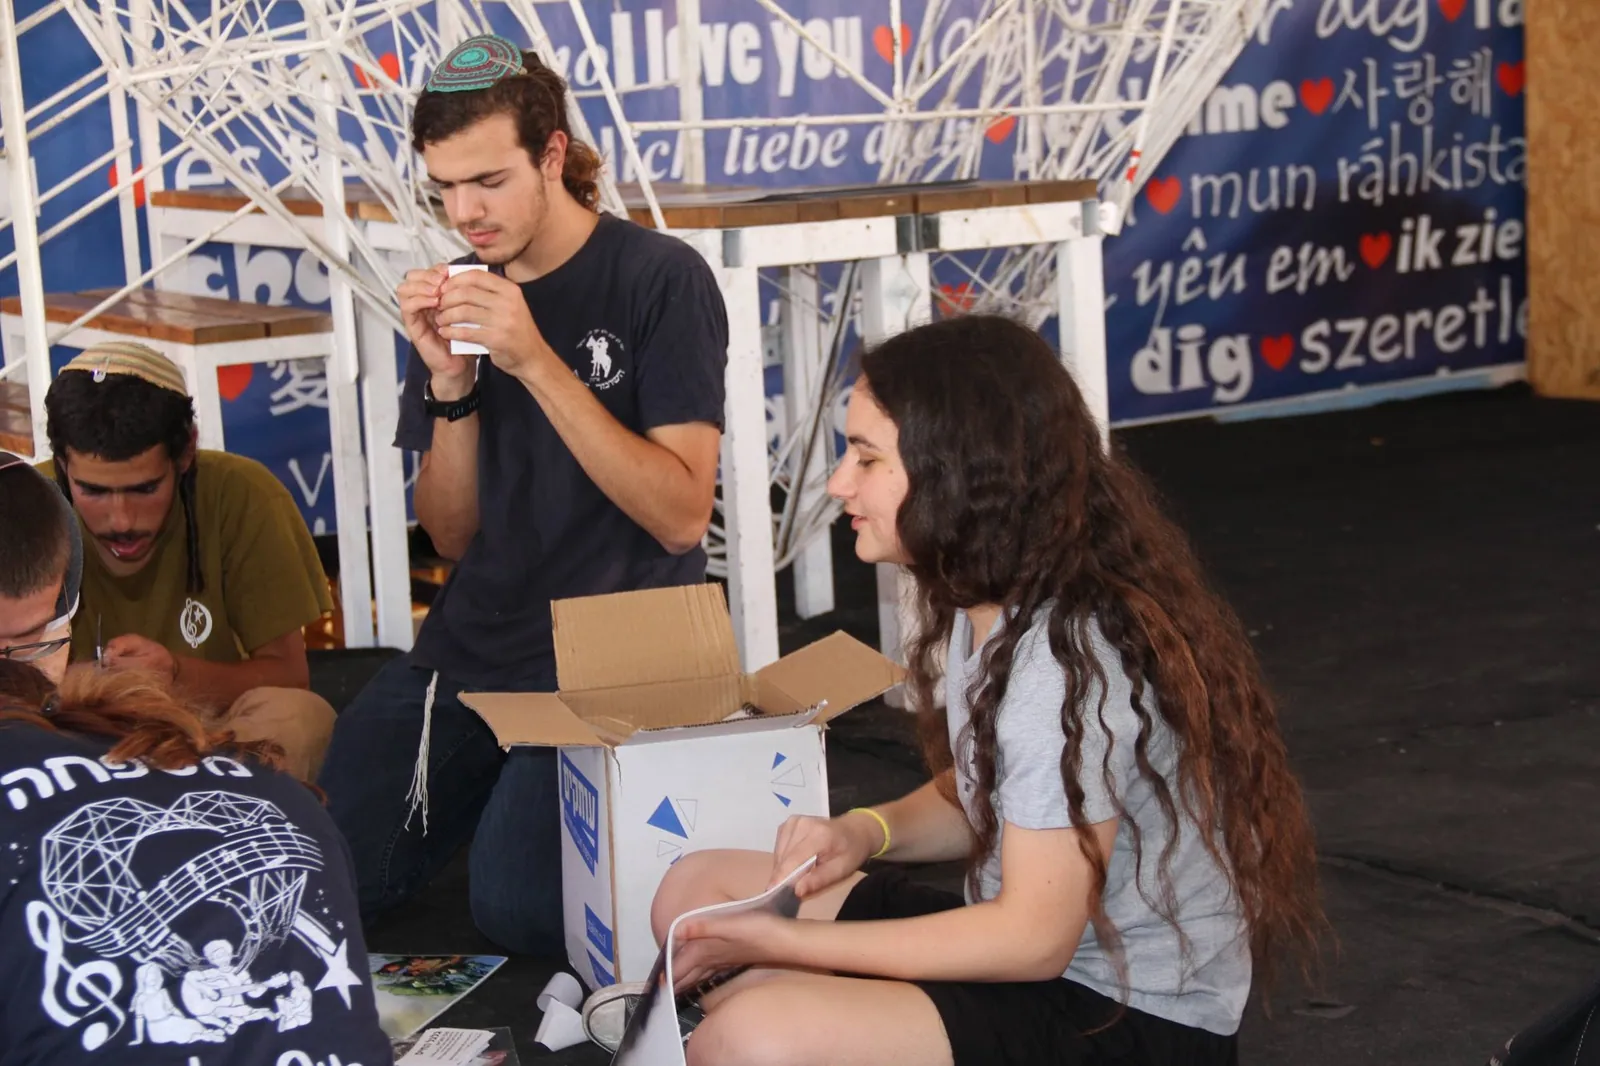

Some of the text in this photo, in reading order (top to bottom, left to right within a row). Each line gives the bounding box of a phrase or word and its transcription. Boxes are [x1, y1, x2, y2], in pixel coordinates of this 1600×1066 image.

[770, 16, 864, 97] you
[1331, 46, 1493, 130] 사랑해
[723, 112, 849, 176] liebe
[1190, 164, 1317, 218] mun
[1396, 206, 1523, 273] ik zie
[1132, 226, 1356, 346] yêu em
[1129, 323, 1254, 404] dig
